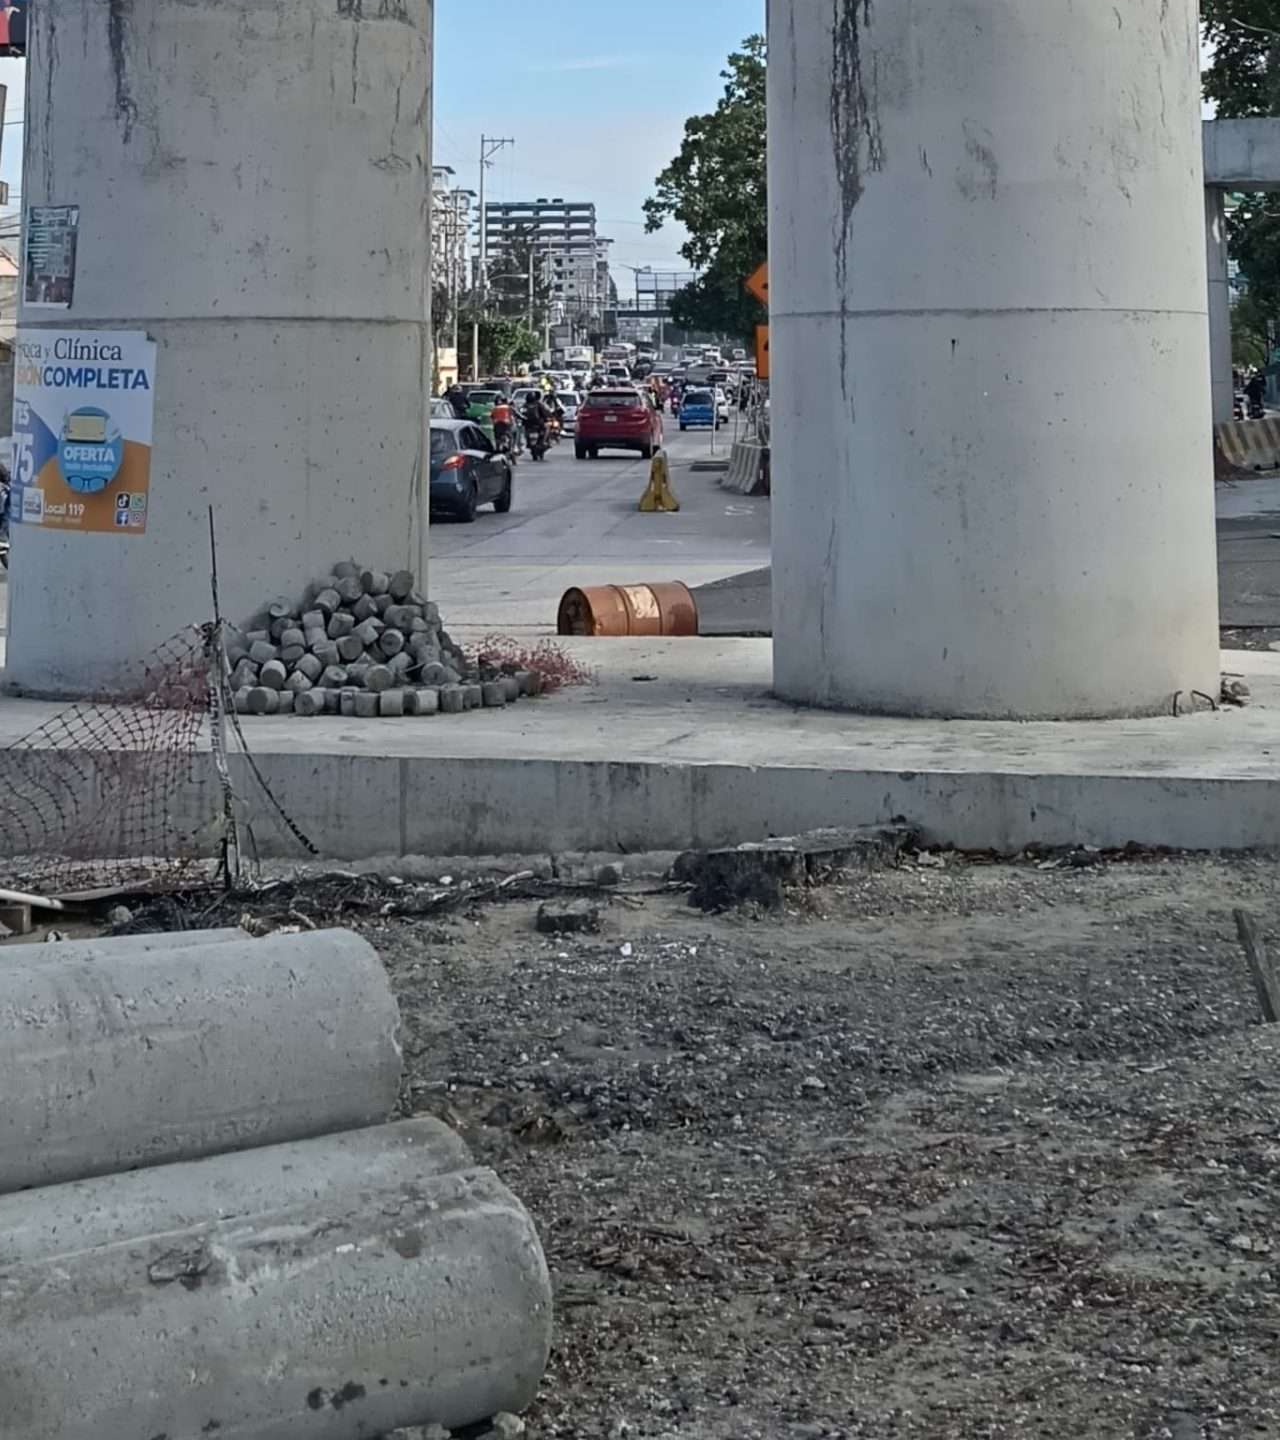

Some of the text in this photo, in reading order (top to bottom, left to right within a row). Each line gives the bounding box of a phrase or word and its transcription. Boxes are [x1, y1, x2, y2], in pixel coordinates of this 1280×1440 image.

[54, 337, 123, 361] Clínica
[43, 366, 150, 390] COMPLETA
[63, 446, 115, 463] OFERTA
[44, 501, 67, 514] Local
[68, 503, 85, 516] 119
